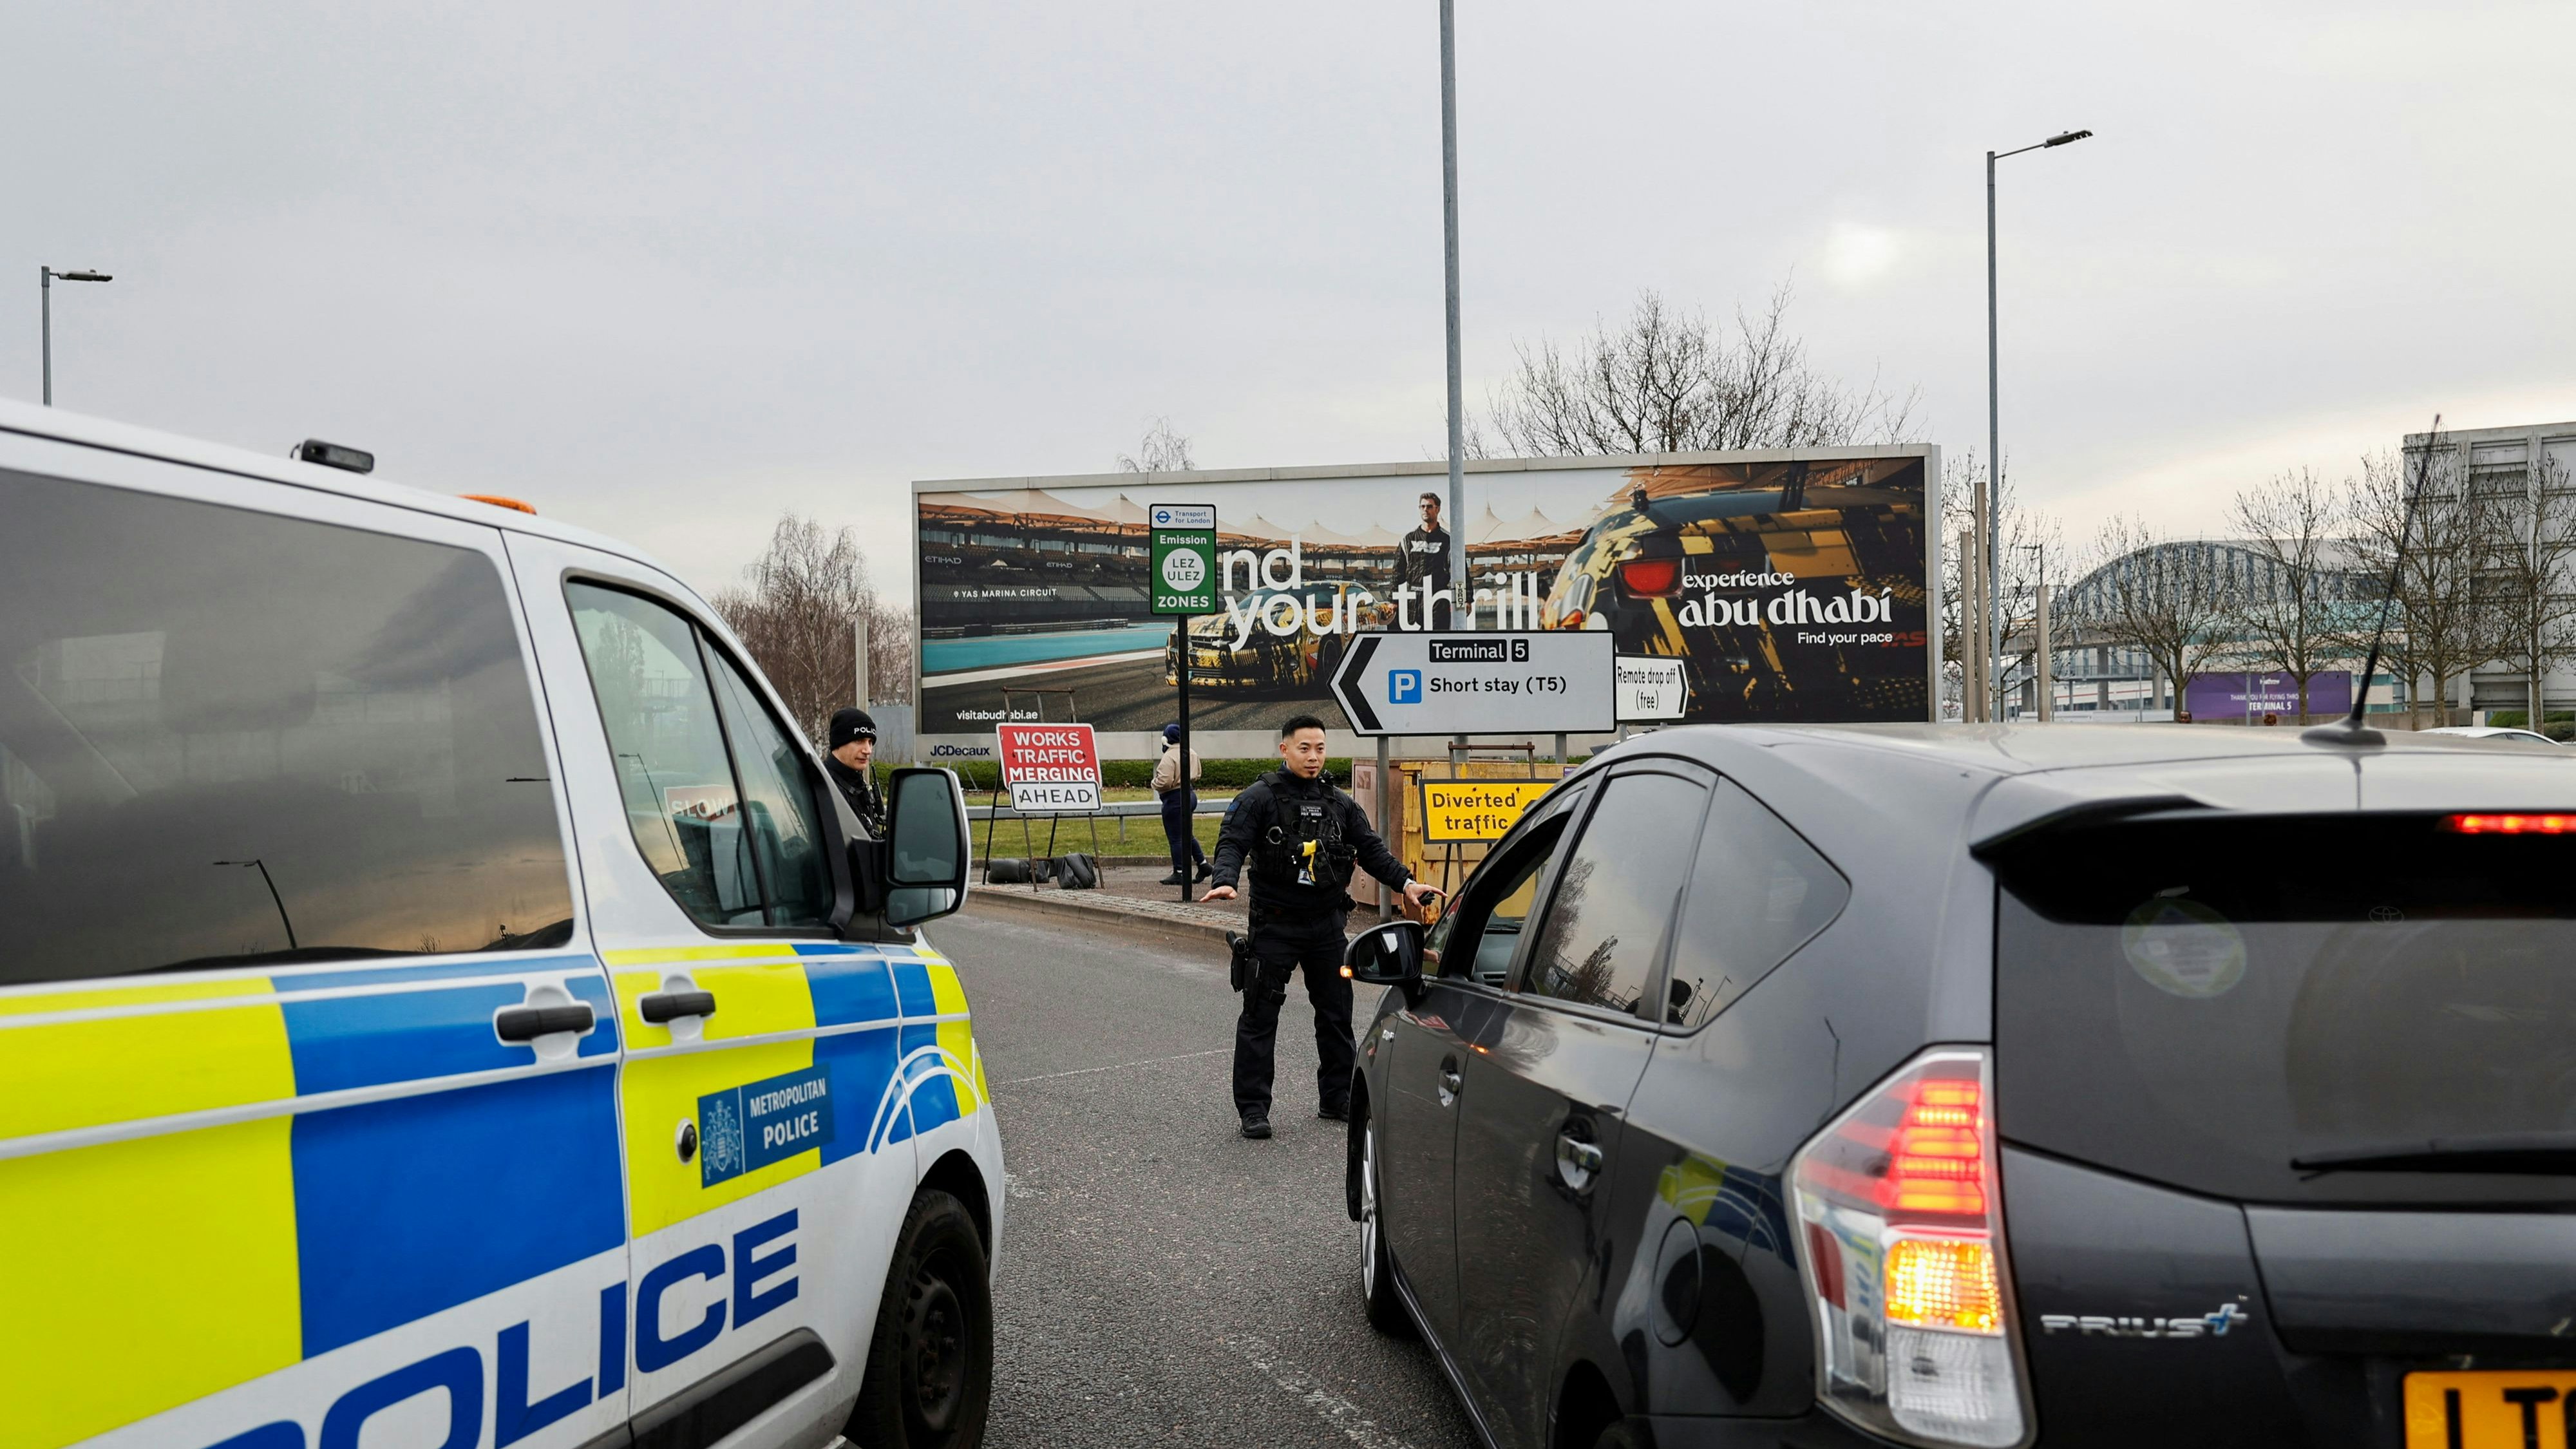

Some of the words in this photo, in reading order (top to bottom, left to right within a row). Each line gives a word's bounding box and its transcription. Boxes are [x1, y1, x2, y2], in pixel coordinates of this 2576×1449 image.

[1160, 535, 1207, 544] Emission
[925, 556, 961, 564] ETIHAD
[1173, 558, 1195, 568] LEZ
[1223, 533, 1301, 591] nd
[1168, 571, 1200, 580] ULEZ
[981, 589, 1016, 598] MARINA
[1020, 589, 1057, 597] CIRCUIT
[1158, 596, 1209, 607] ZONES
[1678, 591, 1760, 627] abu
[1224, 592, 1373, 651] your
[1392, 571, 1538, 631] thrill
[1797, 632, 1826, 644] Find
[1828, 634, 1857, 646] your
[1861, 633, 1893, 646] pace
[1432, 643, 1504, 659] Terminal
[1515, 643, 1526, 659] 5
[1617, 666, 1645, 684] Remote
[1648, 667, 1664, 687] drop
[1666, 668, 1676, 684] off
[1395, 673, 1416, 701] P
[1430, 677, 1479, 693] Short
[1484, 678, 1520, 695] stay
[1526, 676, 1567, 695] (T5)
[1636, 689, 1659, 711] (free)
[2287, 701, 2292, 710] 5
[1013, 732, 1081, 747] WORKS
[930, 745, 990, 757] JCDecaux
[1014, 749, 1085, 764] TRAFFIC
[1009, 767, 1095, 781] MERGING
[1020, 789, 1091, 803] AHEAD
[1432, 792, 1516, 808] Diverted
[672, 798, 729, 818] SLOW
[1445, 814, 1508, 831] traffic
[750, 1077, 826, 1118] METROPOLITAN
[764, 1111, 819, 1150] POLICE
